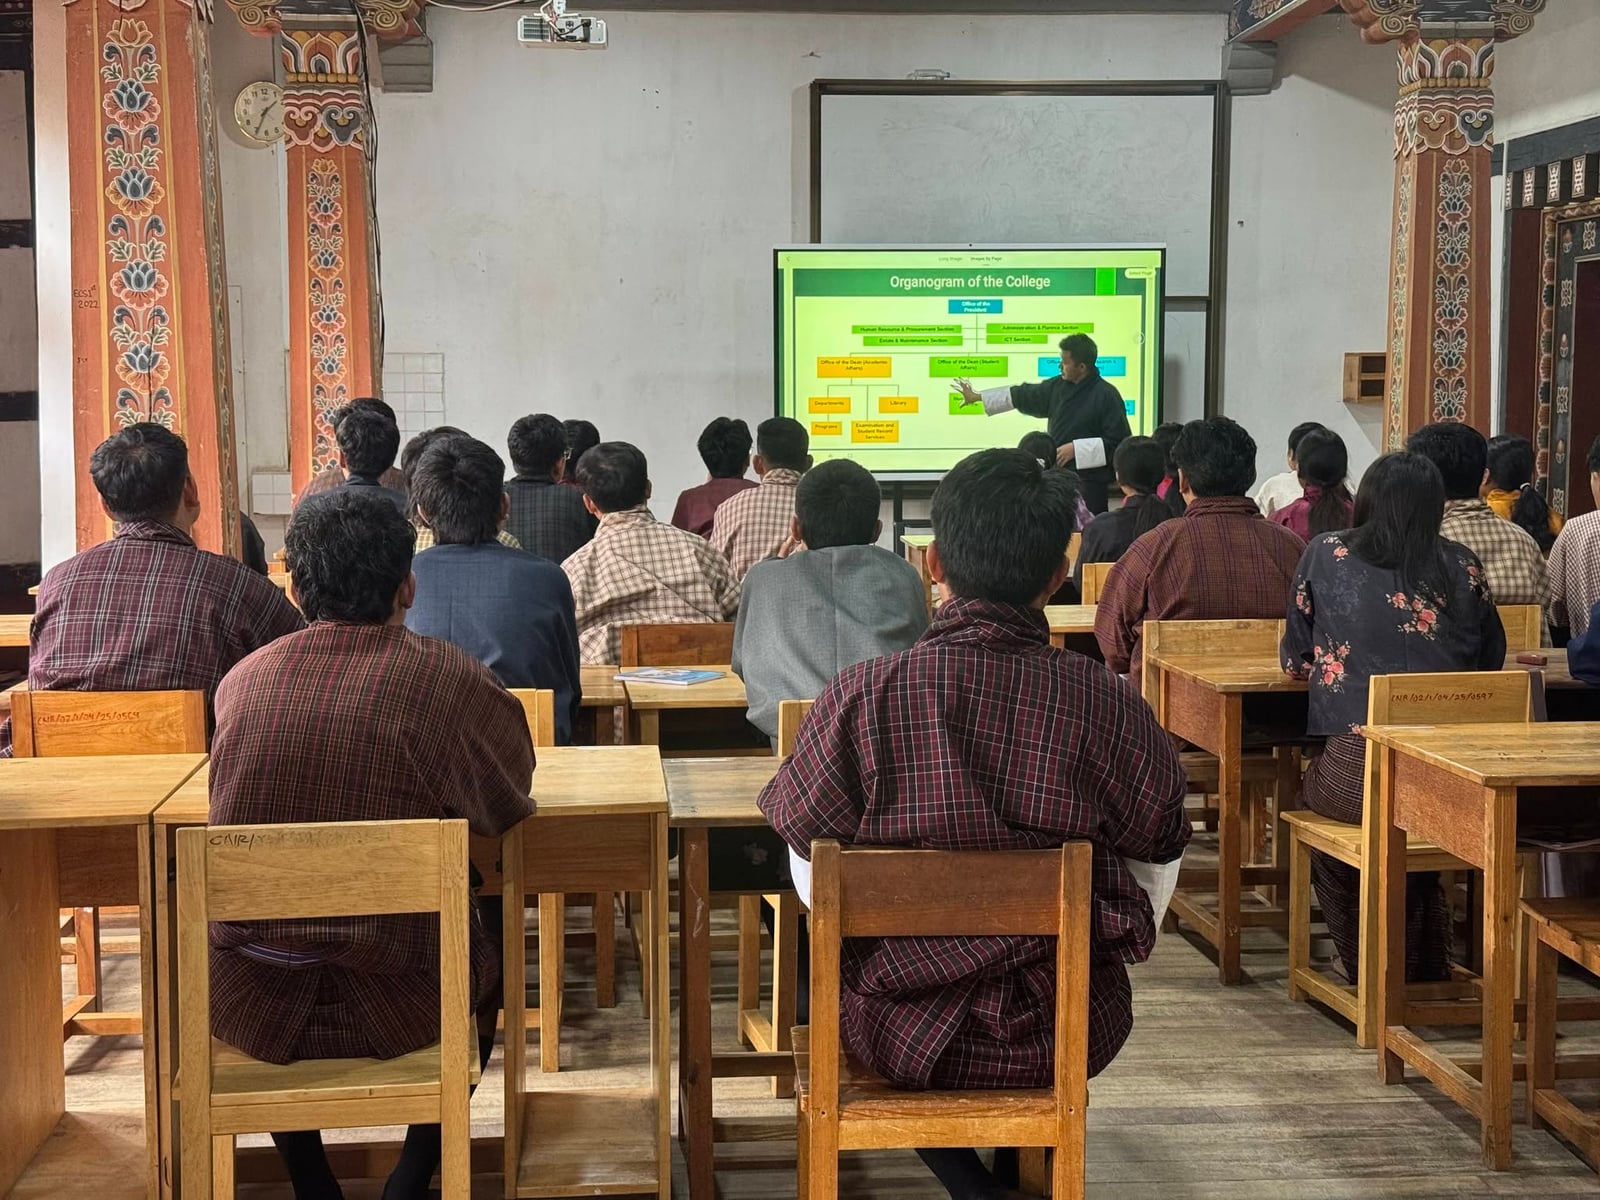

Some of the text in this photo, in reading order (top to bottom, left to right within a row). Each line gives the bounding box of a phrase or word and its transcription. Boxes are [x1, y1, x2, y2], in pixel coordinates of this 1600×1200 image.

[890, 275, 1050, 291] Organogram of the College
[78, 300, 100, 309] 2022
